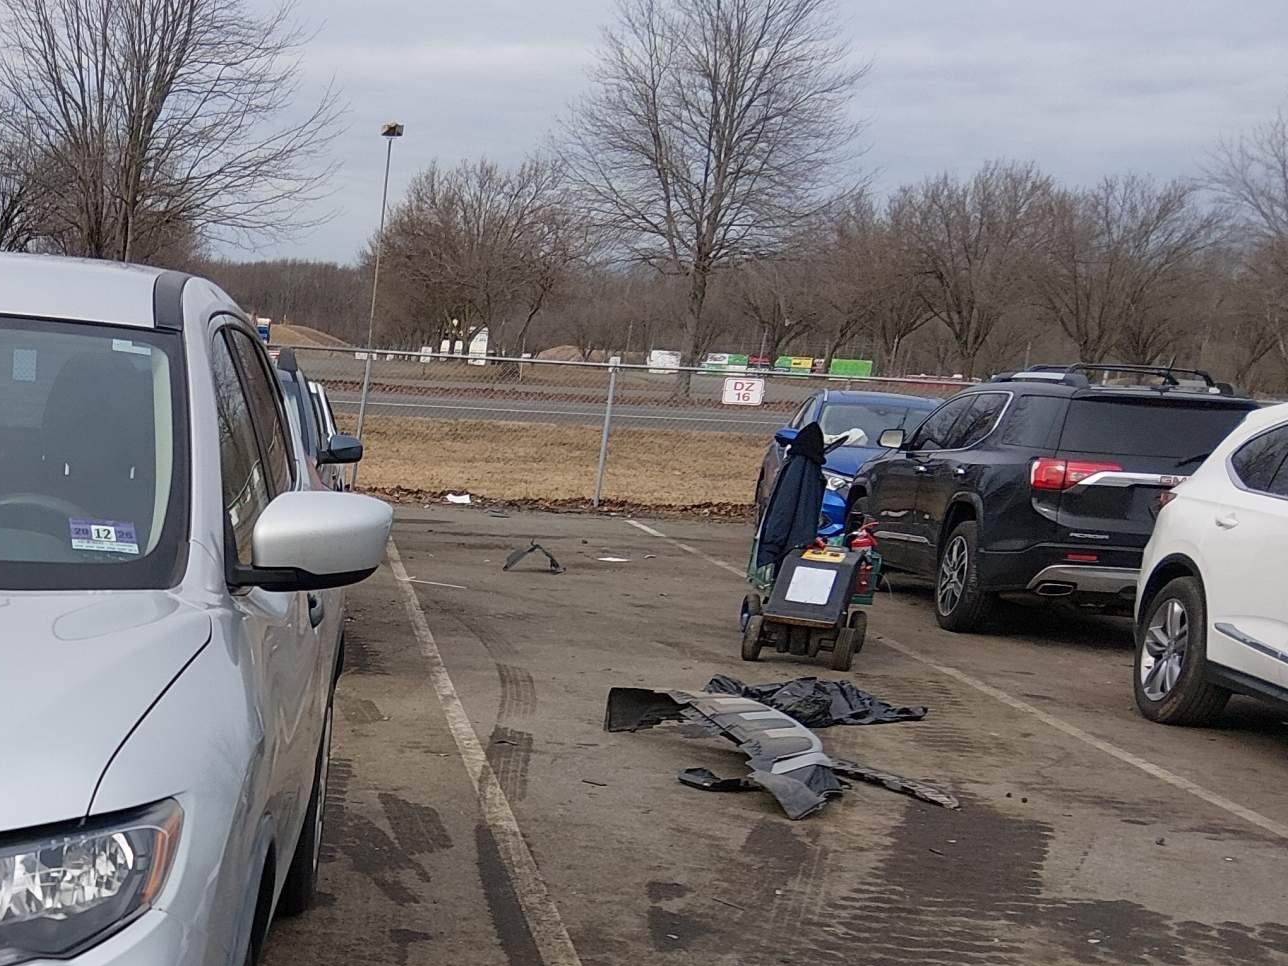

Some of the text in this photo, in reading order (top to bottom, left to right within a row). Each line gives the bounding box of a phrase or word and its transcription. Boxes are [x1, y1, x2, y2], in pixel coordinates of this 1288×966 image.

[734, 381, 756, 391] DZ
[736, 392, 751, 402] 16
[95, 528, 112, 540] 12
